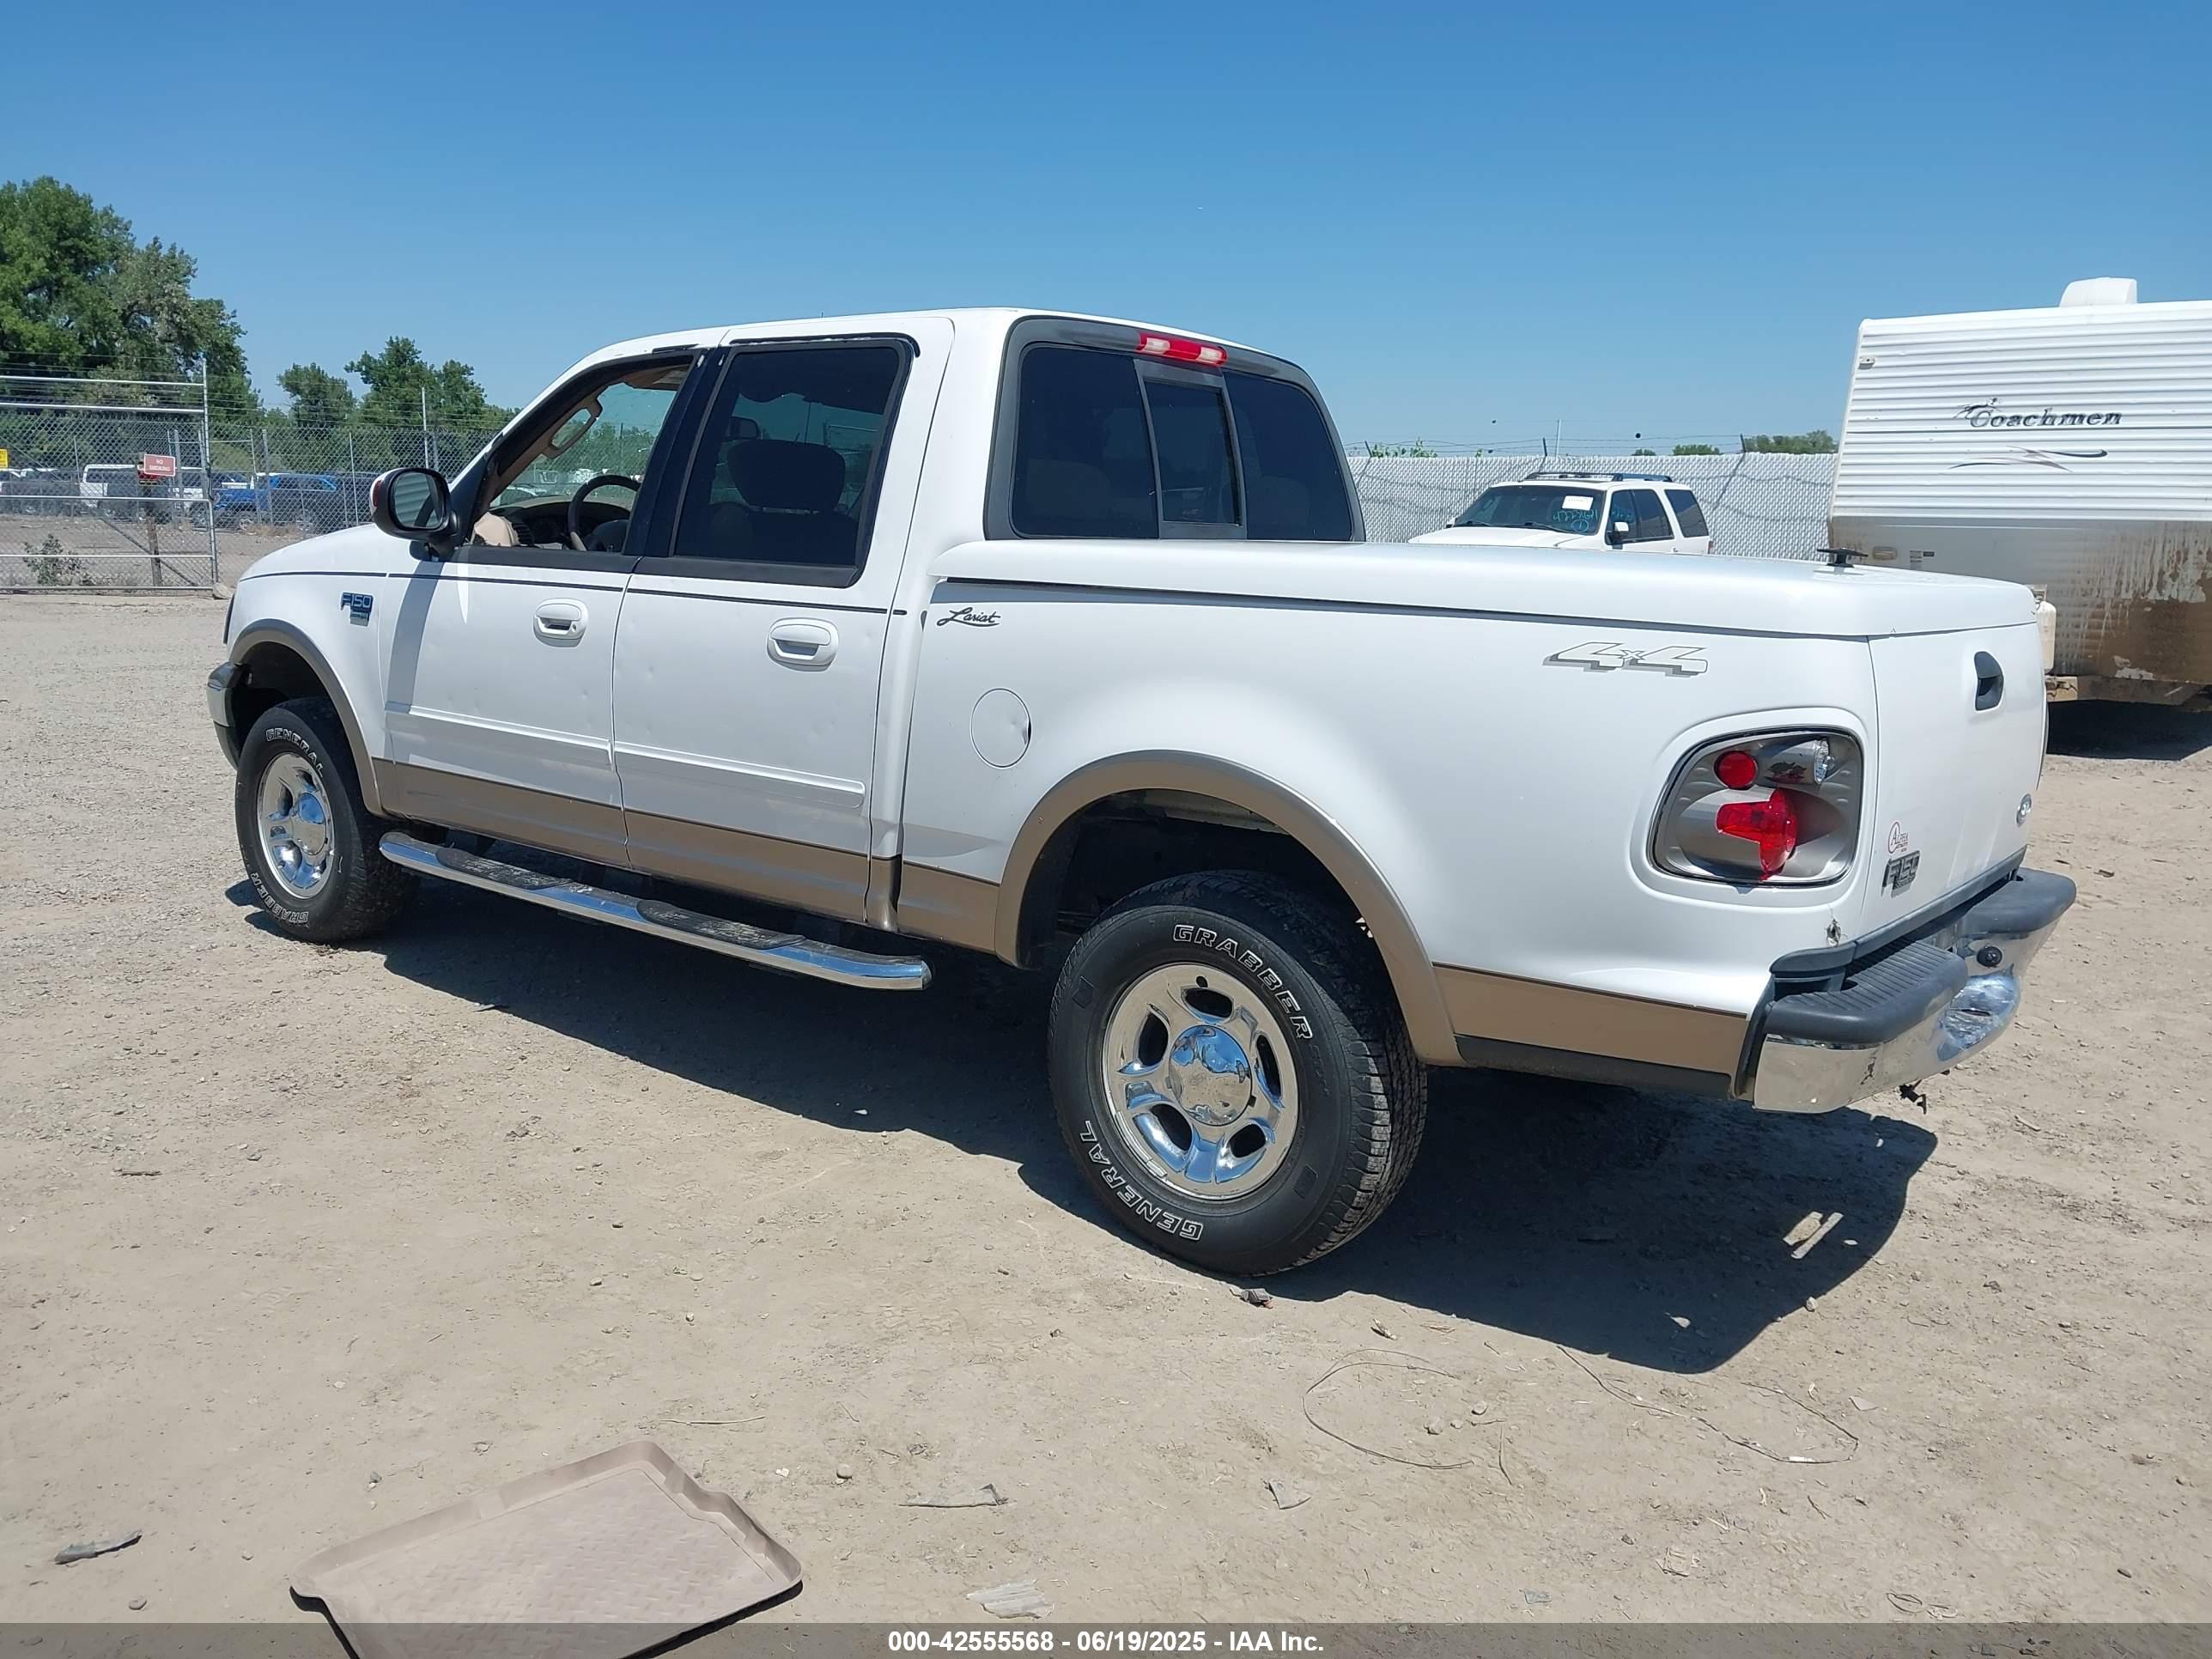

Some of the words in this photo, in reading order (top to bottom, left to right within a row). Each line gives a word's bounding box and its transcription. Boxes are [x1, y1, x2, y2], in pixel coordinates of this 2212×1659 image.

[1970, 407, 2123, 428] Coachmen
[937, 606, 1001, 627] Lariat
[265, 726, 325, 778] GENERAL
[250, 871, 310, 925] GRABBER
[1173, 923, 1313, 1040] GRABBER
[1079, 1120, 1204, 1242] GENERAL
